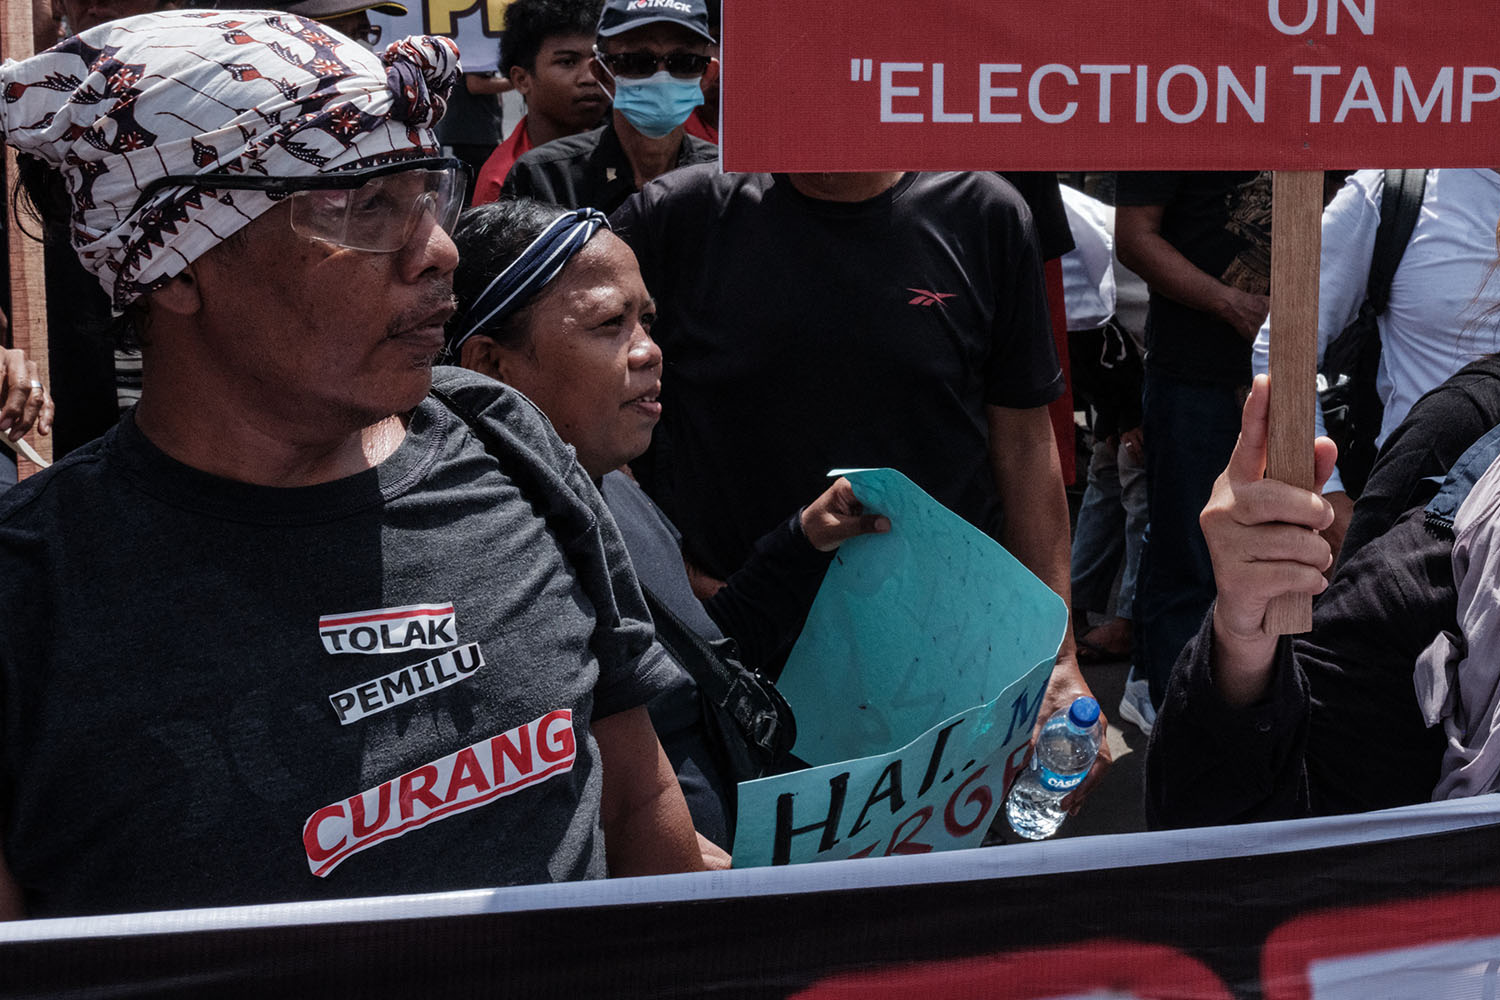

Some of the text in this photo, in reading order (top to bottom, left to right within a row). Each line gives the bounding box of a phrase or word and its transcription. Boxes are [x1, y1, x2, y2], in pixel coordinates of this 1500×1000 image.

[850, 58, 1266, 125] "ELECTION
[322, 616, 454, 652] TOLAK
[330, 645, 481, 721] PEMILU
[305, 710, 575, 862] CURANG
